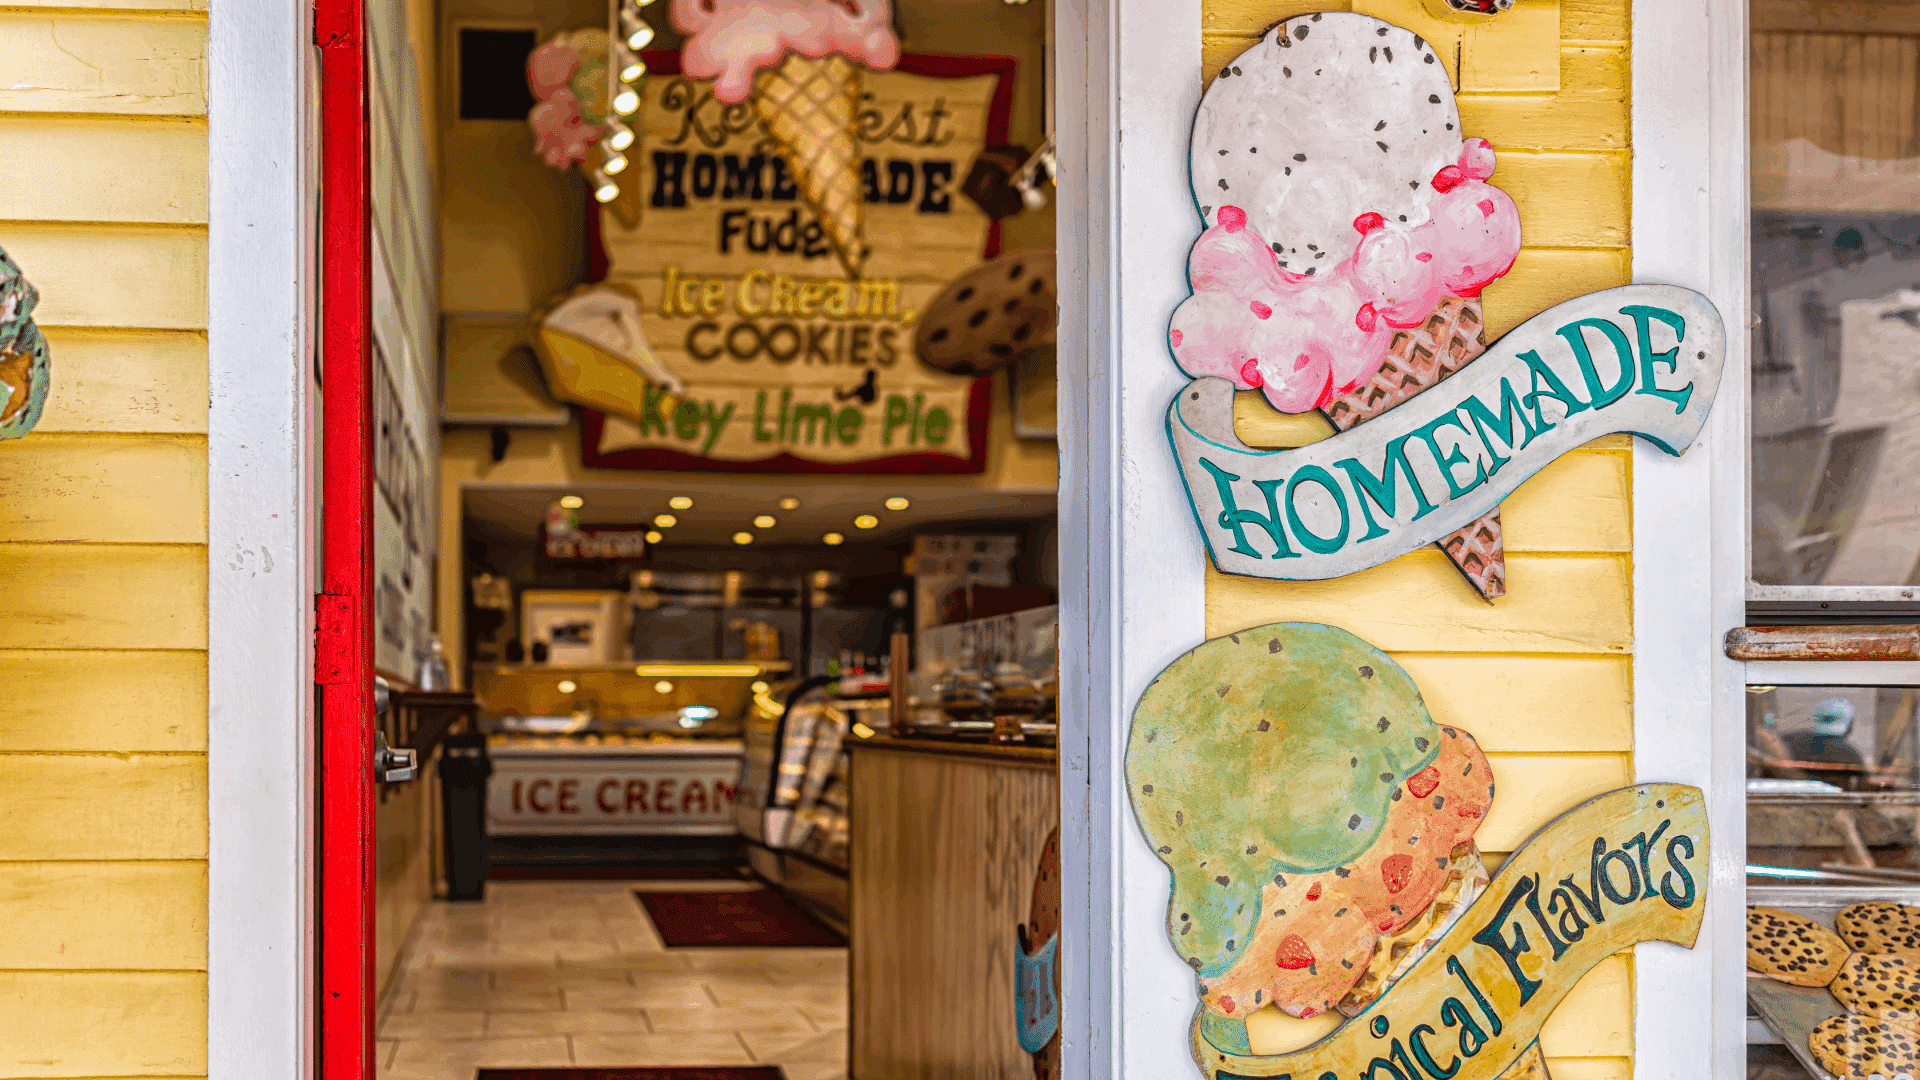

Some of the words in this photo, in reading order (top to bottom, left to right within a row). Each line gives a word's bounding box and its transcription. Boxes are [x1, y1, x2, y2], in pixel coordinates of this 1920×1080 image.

[856, 91, 956, 147] est
[652, 151, 953, 213] HOMEADE
[662, 266, 725, 315] Ice
[686, 321, 900, 367] COOKIES
[641, 383, 737, 452] Key
[755, 390, 864, 444] Lime
[883, 394, 951, 446] Pie
[1199, 304, 1695, 560] HOMEMADE
[512, 778, 582, 814] ICE
[1471, 818, 1696, 1008] Flavors
